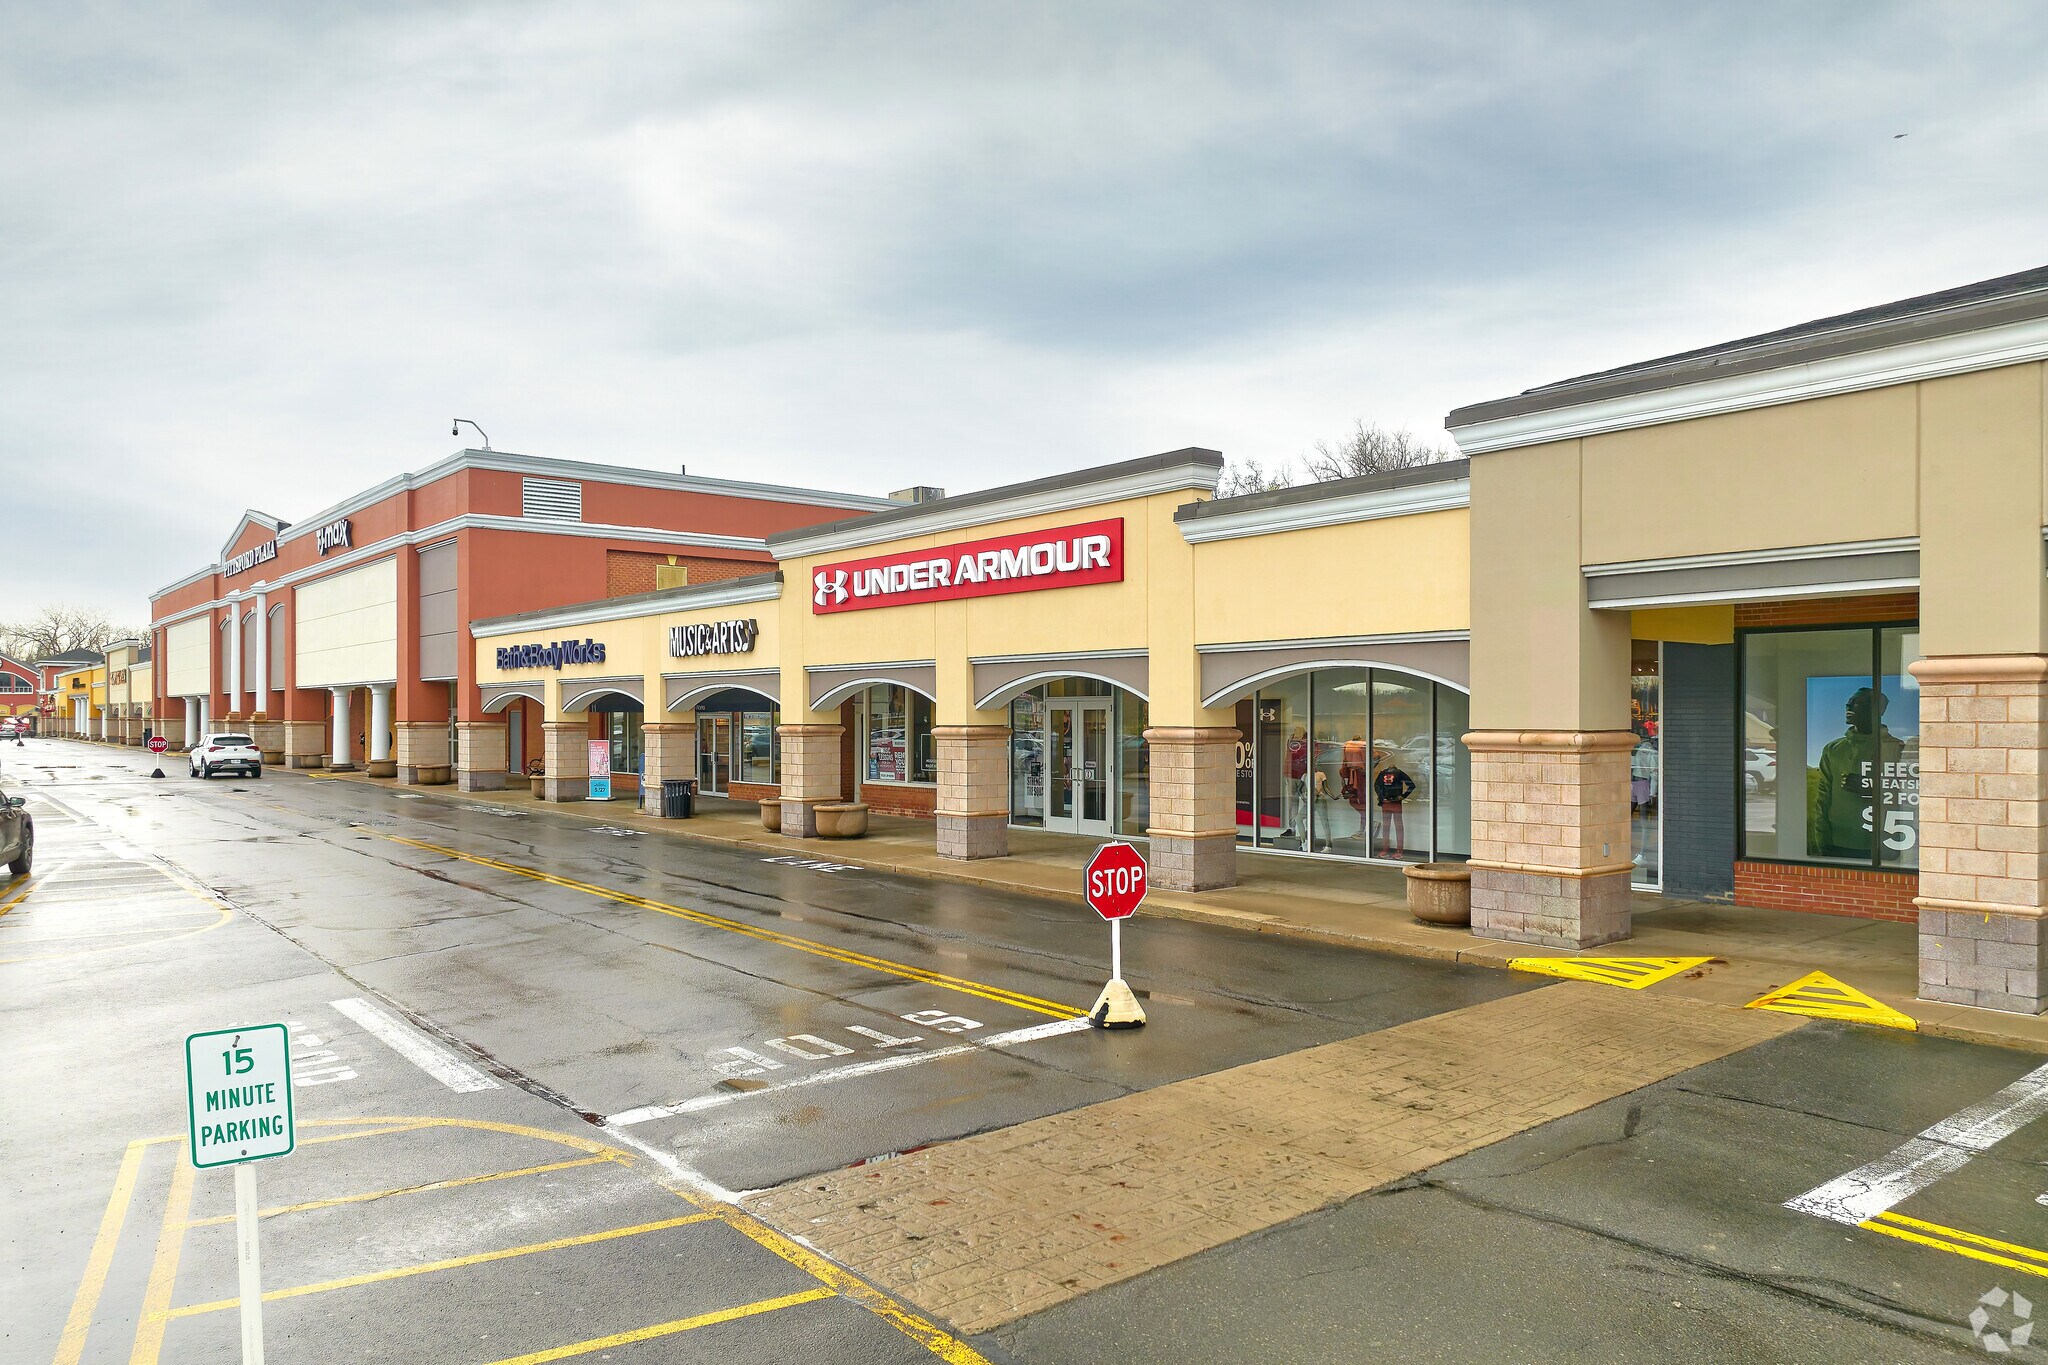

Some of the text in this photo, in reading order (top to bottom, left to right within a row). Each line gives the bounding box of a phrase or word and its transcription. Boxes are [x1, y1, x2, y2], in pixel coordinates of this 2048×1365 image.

[224, 540, 278, 578] PITTSFORD PLAZA
[852, 534, 1111, 597] UNDER ARMOUR
[561, 638, 606, 665] Works
[1861, 762, 1919, 778] FEEC
[1883, 792, 1894, 805] 2
[1091, 866, 1143, 898] STOP
[711, 1010, 985, 1078] STOP
[222, 1047, 255, 1076] 15
[205, 1082, 276, 1112] MINUTE
[201, 1115, 283, 1147] PARKING
